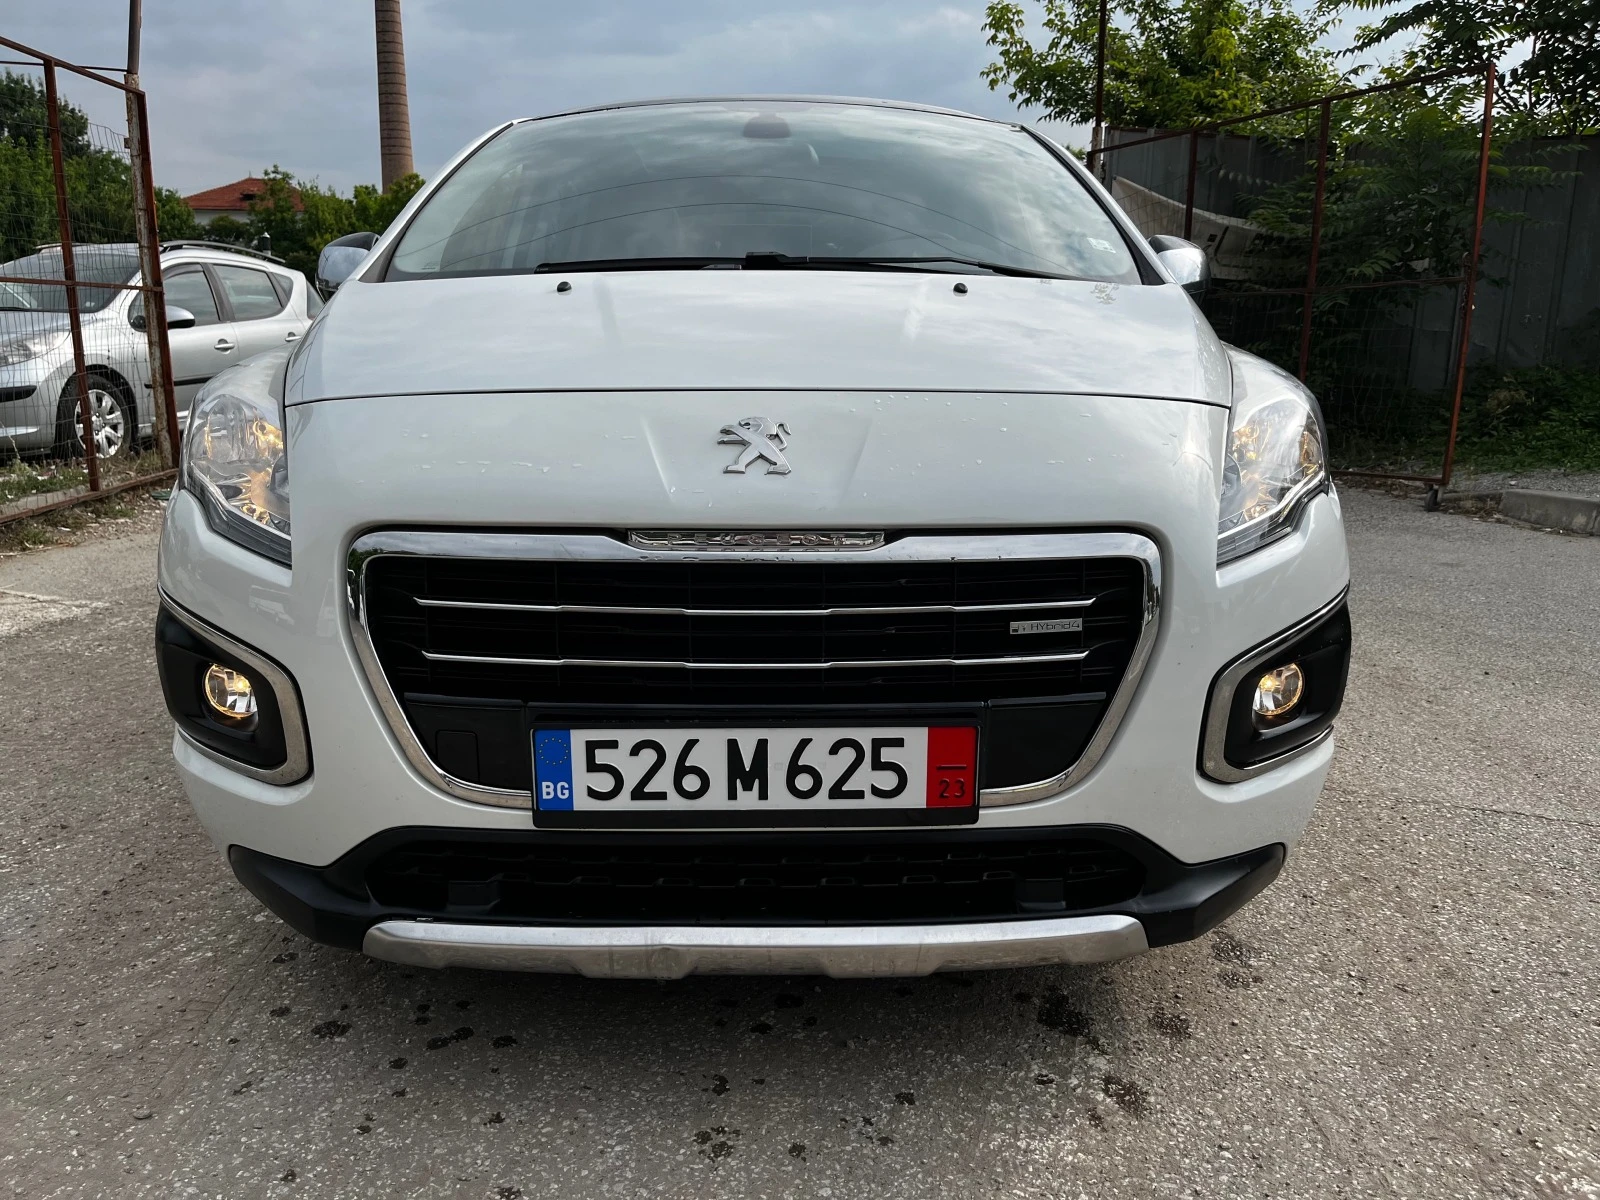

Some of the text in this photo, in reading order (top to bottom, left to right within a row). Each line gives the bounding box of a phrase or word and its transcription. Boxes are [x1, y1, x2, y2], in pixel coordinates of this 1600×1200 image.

[585, 737, 908, 801] 526 M 625
[541, 781, 570, 799] BG
[938, 778, 966, 799] 23
